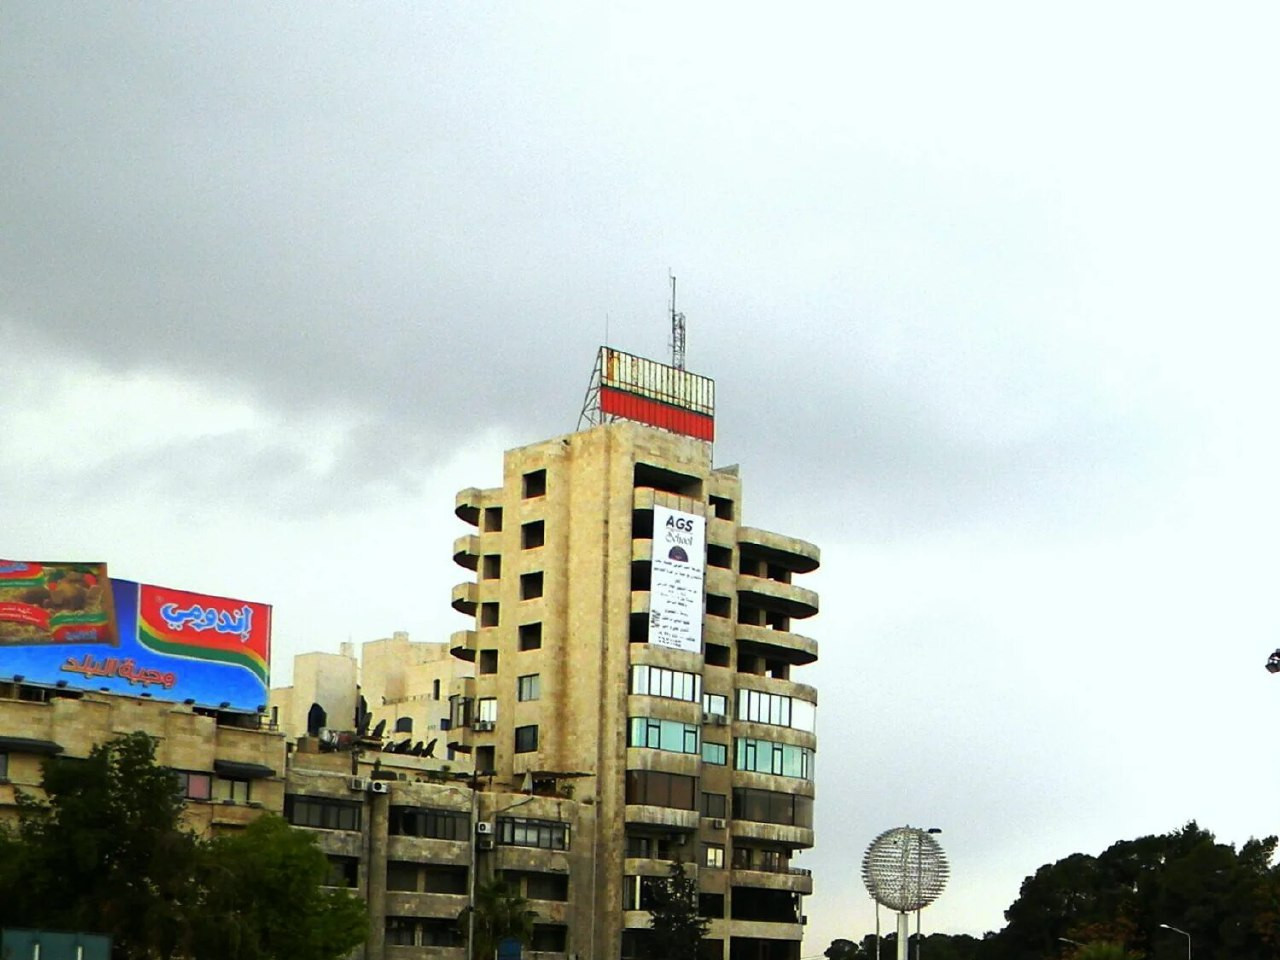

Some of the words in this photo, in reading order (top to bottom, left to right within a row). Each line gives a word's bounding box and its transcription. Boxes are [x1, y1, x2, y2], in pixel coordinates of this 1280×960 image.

[666, 515, 694, 532] AGS
[161, 602, 254, 643] إندومي
[60, 654, 118, 679] البلد
[118, 658, 177, 689] وجبة
